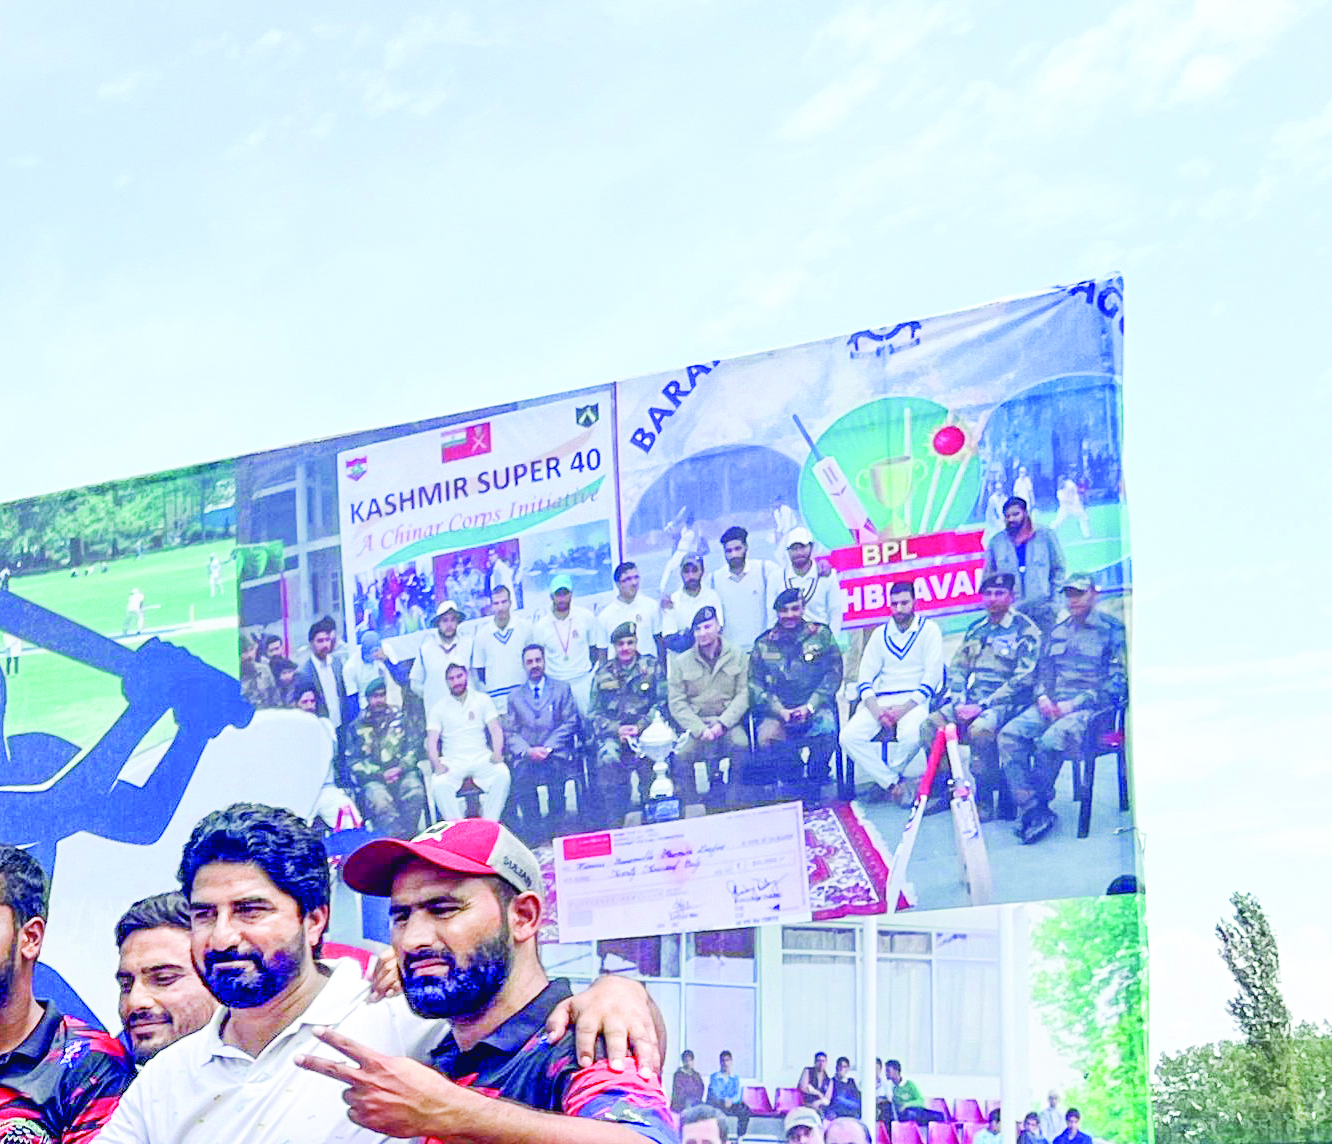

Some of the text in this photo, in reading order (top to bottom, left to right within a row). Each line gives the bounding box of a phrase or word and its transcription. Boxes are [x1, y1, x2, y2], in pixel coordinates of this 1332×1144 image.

[631, 360, 721, 454] BARA
[350, 448, 601, 524] KASHMIR SUPER 40
[357, 487, 599, 557] A Chinar Corps Initiative
[861, 541, 918, 567] BPL
